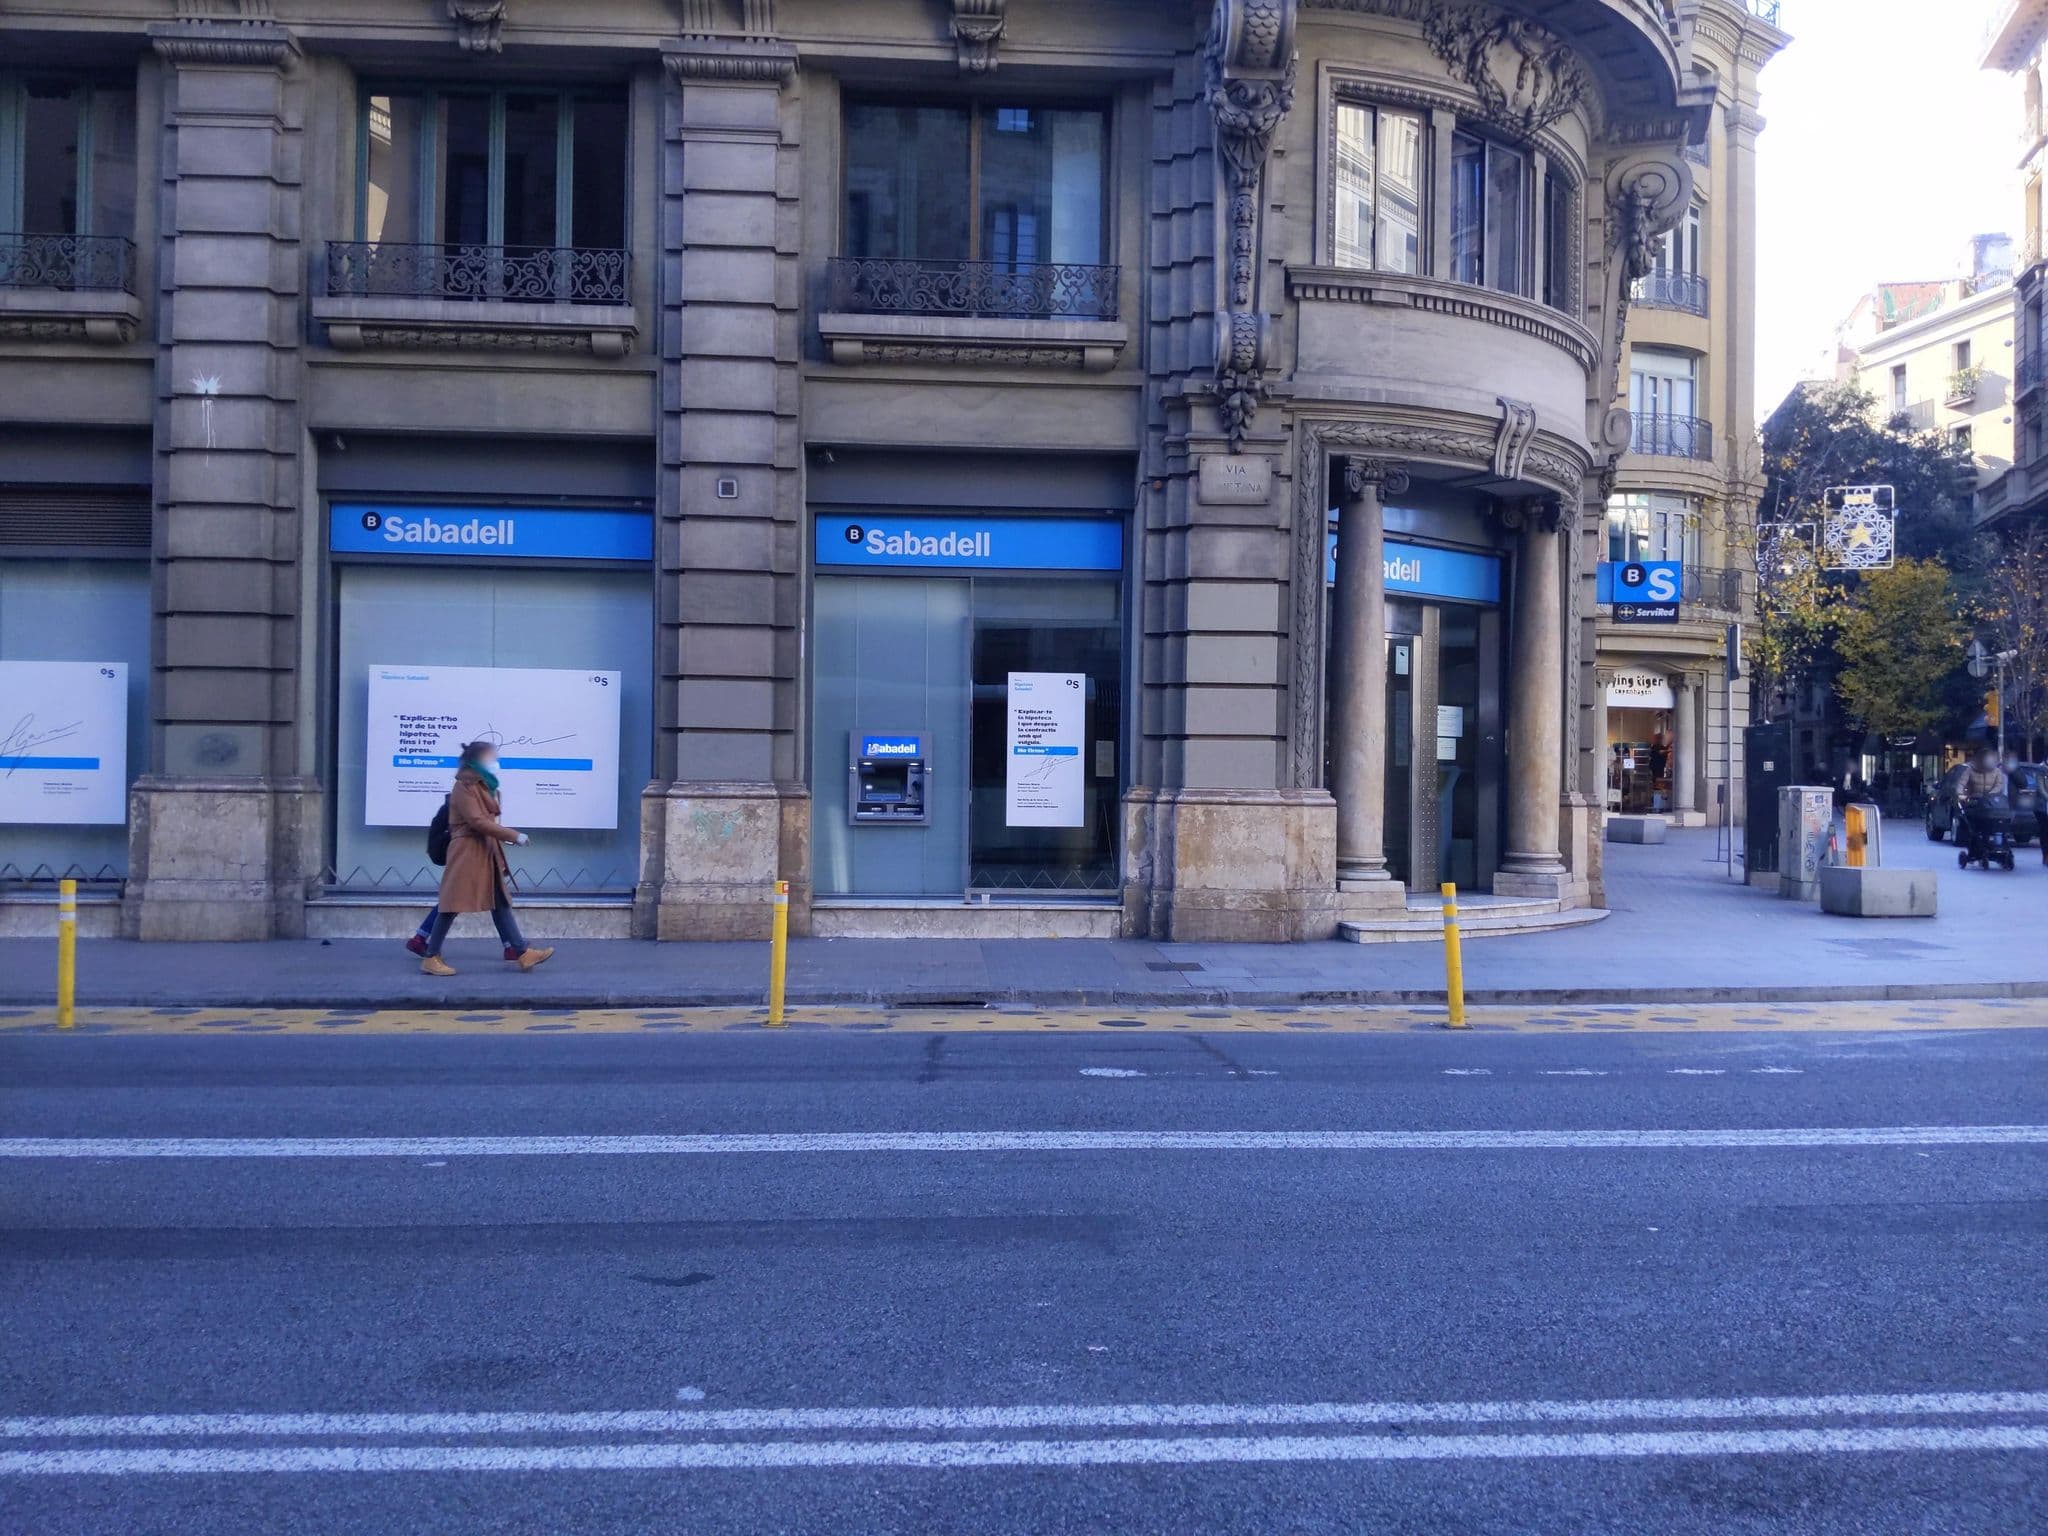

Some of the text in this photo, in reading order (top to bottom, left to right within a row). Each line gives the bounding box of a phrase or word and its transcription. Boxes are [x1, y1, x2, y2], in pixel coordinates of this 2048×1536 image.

[1226, 464, 1246, 474] VIA
[383, 516, 514, 545] Sabadell
[866, 529, 990, 557] Sabadell
[1384, 557, 1421, 583] adell
[1636, 607, 1675, 617] ServiRed
[1611, 674, 1664, 689] ying tiger
[399, 730, 440, 738] hipoteca,
